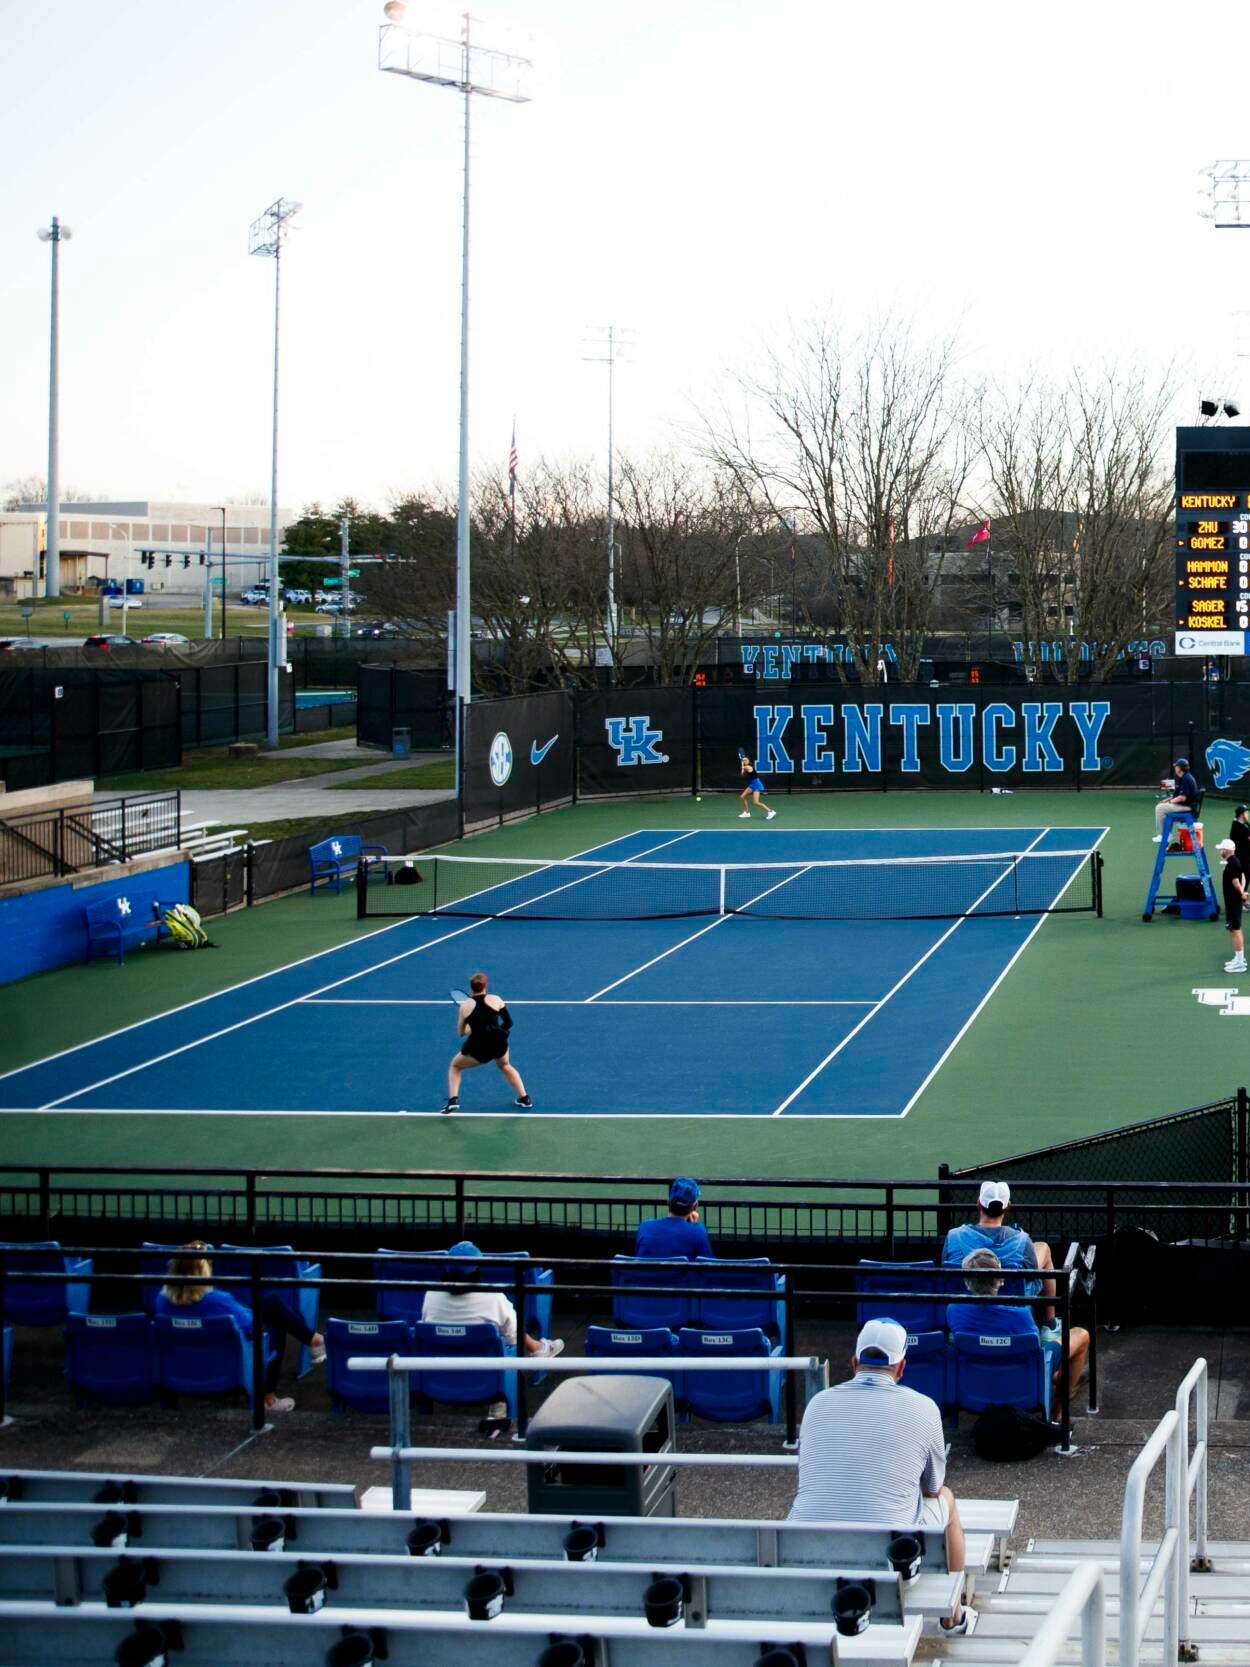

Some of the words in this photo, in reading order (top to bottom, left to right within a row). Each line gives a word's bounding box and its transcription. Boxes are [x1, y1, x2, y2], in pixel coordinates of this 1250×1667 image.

[1181, 495, 1235, 508] KENTUCKY
[1198, 521, 1218, 533] ZHU
[1232, 521, 1248, 533] 30
[1191, 537, 1224, 549] GOMEZ
[1239, 537, 1248, 549] 0
[1187, 561, 1228, 573] HAMMON
[1239, 561, 1248, 573] 0
[1188, 576, 1227, 588] SCHAFE
[1239, 576, 1248, 588] 0
[1192, 600, 1224, 612] SAGER
[1188, 616, 1227, 628] KOSKEL
[1239, 616, 1248, 628] 0
[605, 716, 663, 766] UK
[754, 702, 1110, 773] KENTUCKY
